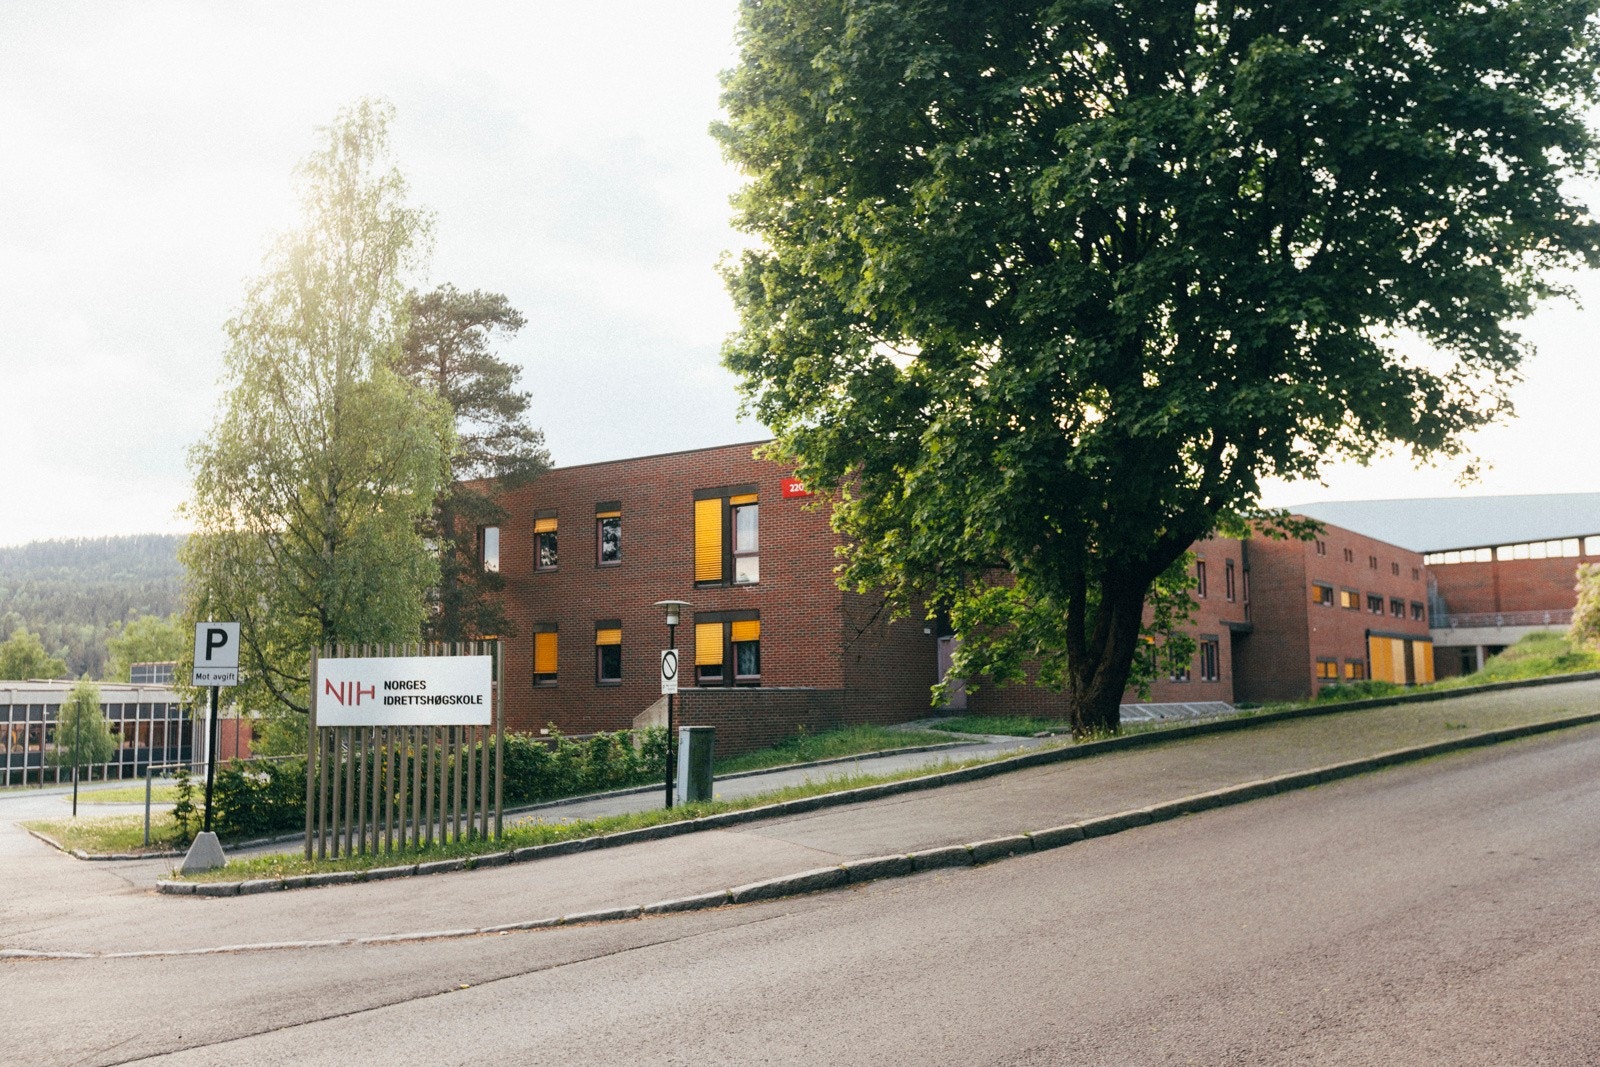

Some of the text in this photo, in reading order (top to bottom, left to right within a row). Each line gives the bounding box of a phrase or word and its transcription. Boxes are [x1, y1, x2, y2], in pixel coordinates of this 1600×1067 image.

[206, 628, 228, 661] P
[213, 673, 235, 682] avgift
[384, 680, 426, 690] NORGES
[325, 678, 375, 706] NIH
[383, 695, 483, 706] IDRETTSHØGSKOLE
